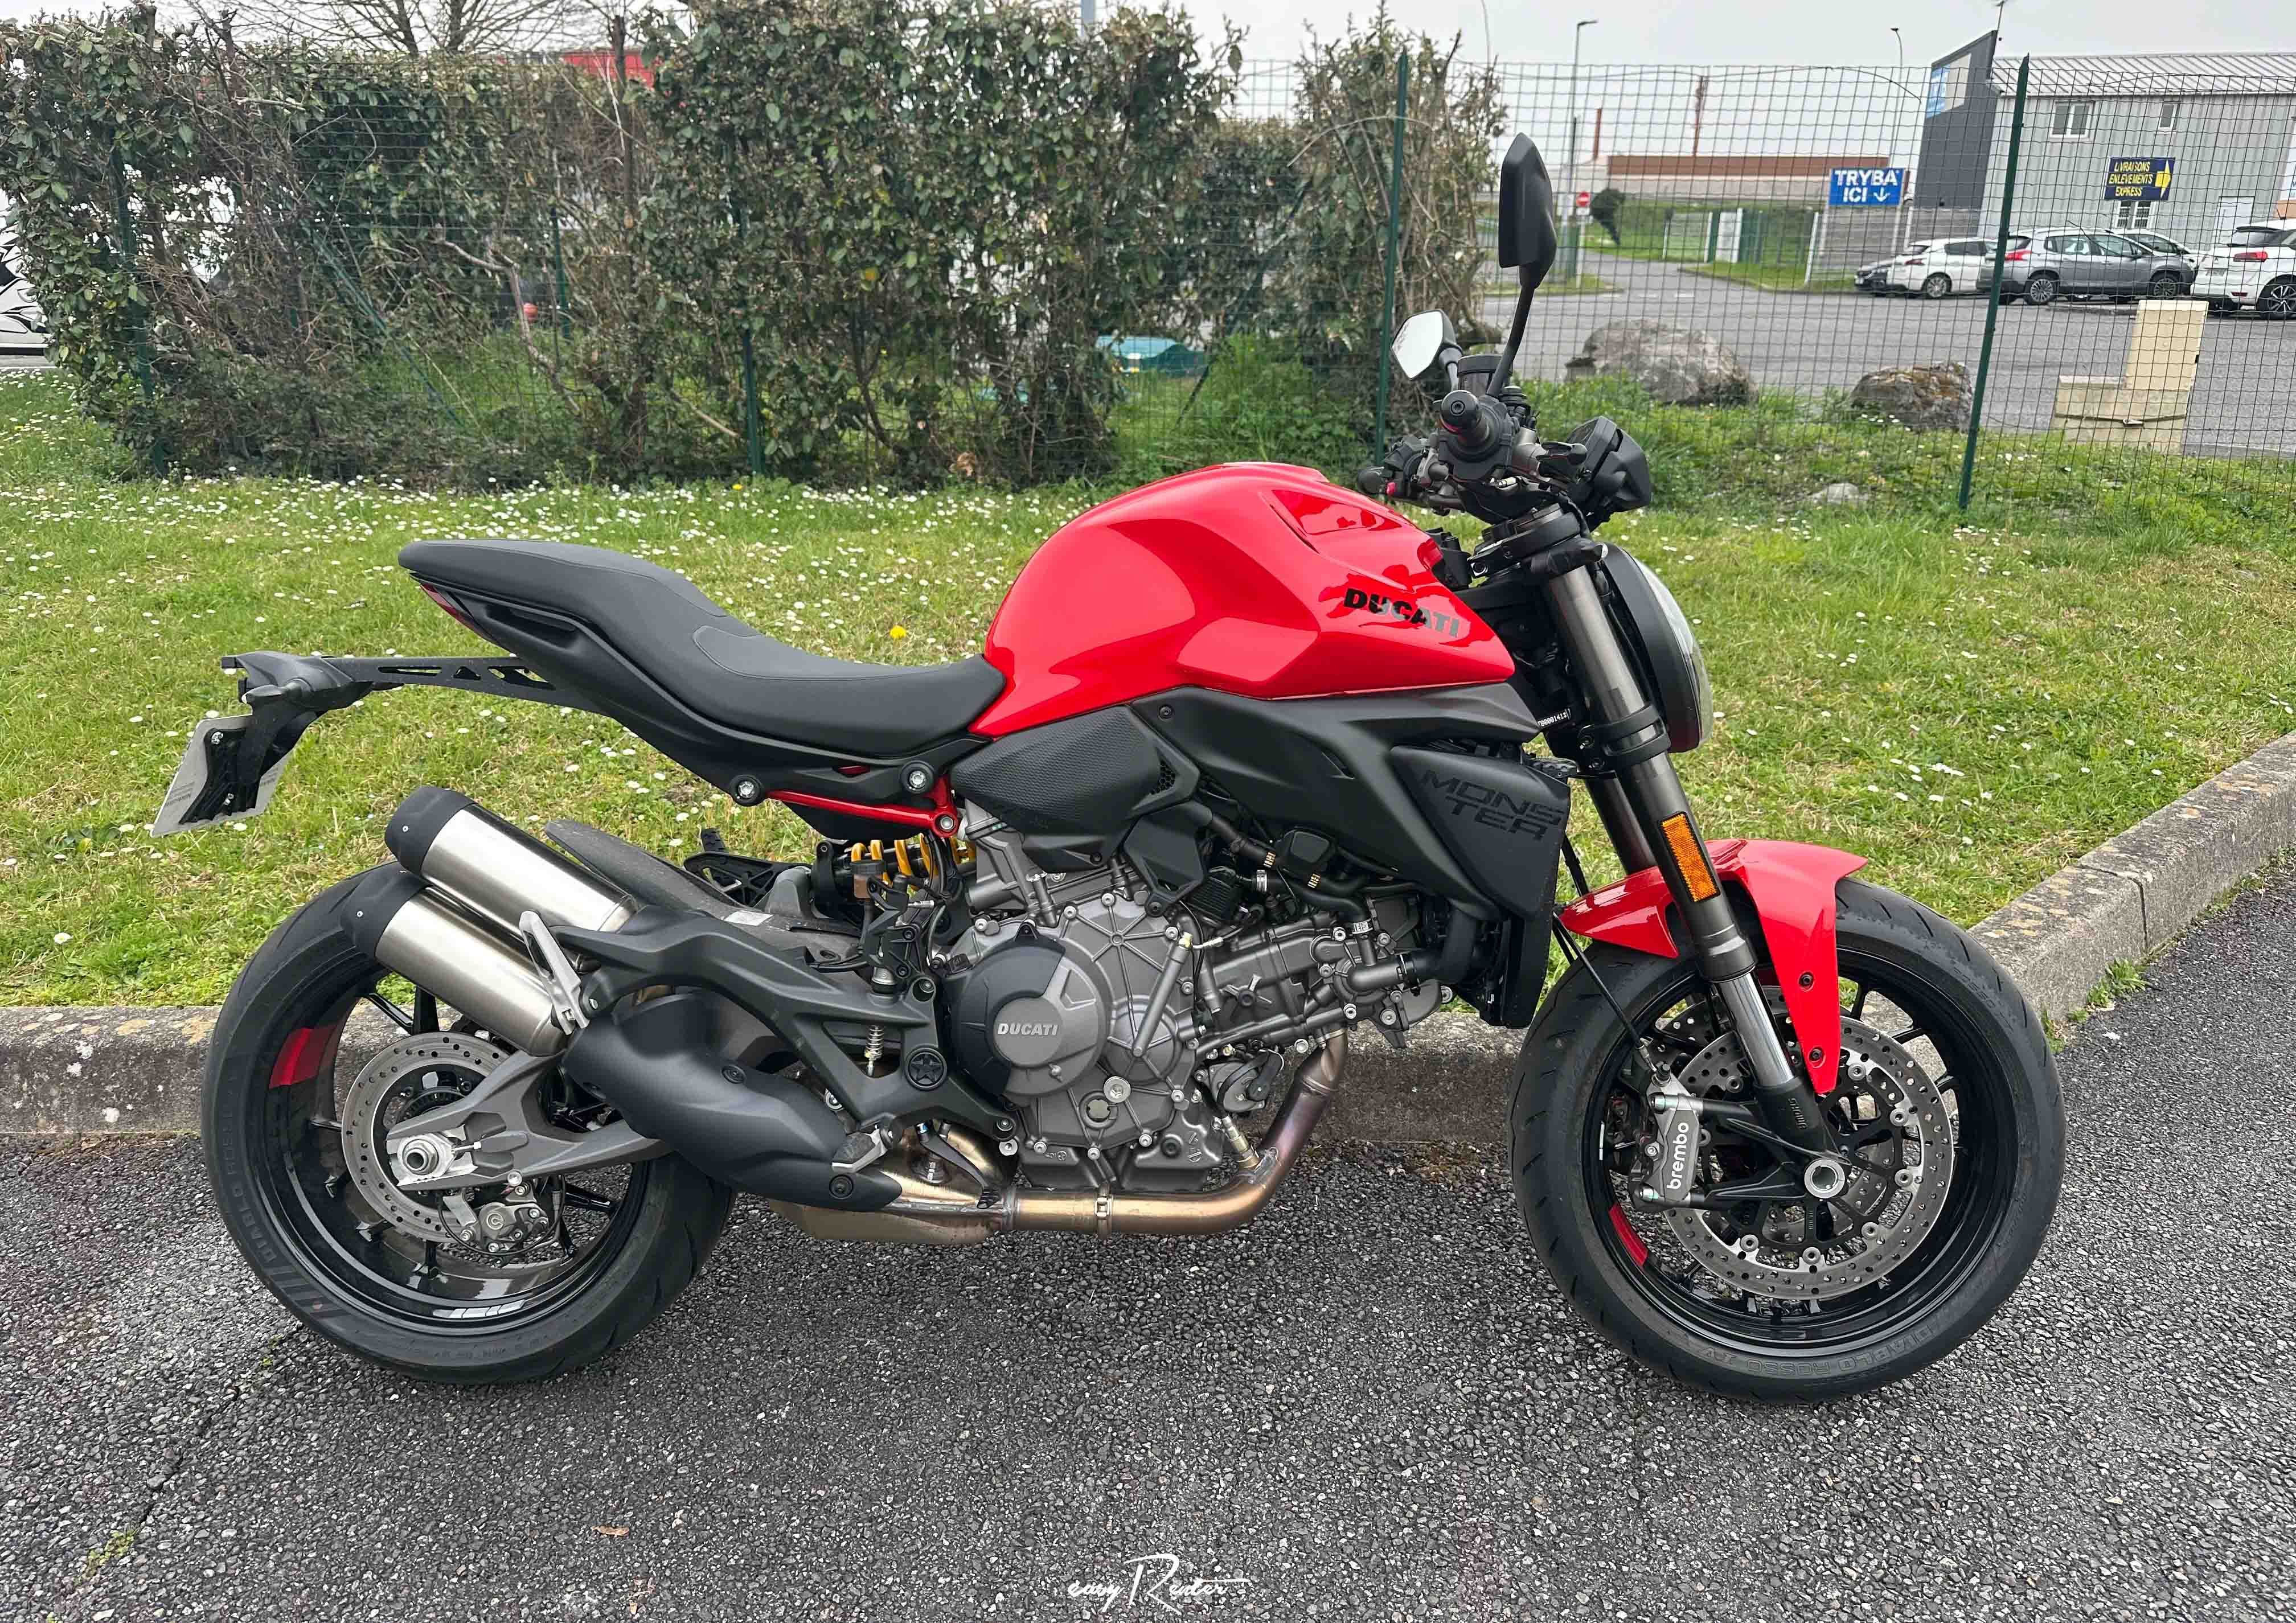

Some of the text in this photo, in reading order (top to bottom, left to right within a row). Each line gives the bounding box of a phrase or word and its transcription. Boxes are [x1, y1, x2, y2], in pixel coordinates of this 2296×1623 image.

[2114, 161, 2151, 172] LIVRAISONS
[1834, 169, 1899, 186] TRYBA
[2109, 173, 2153, 184] ENLEVEMENTS
[1843, 187, 1868, 202] ICI
[2115, 186, 2143, 196] EXPRESS
[1344, 587, 1460, 638] DUCATI
[1424, 769, 1565, 825] MONS
[1445, 795, 1548, 841] TER
[998, 1023, 1059, 1036] DUCATI
[1666, 1122, 1690, 1189] brembo
[1838, 1324, 1935, 1371] DIABLO
[1747, 1358, 1831, 1377] ROSSO
